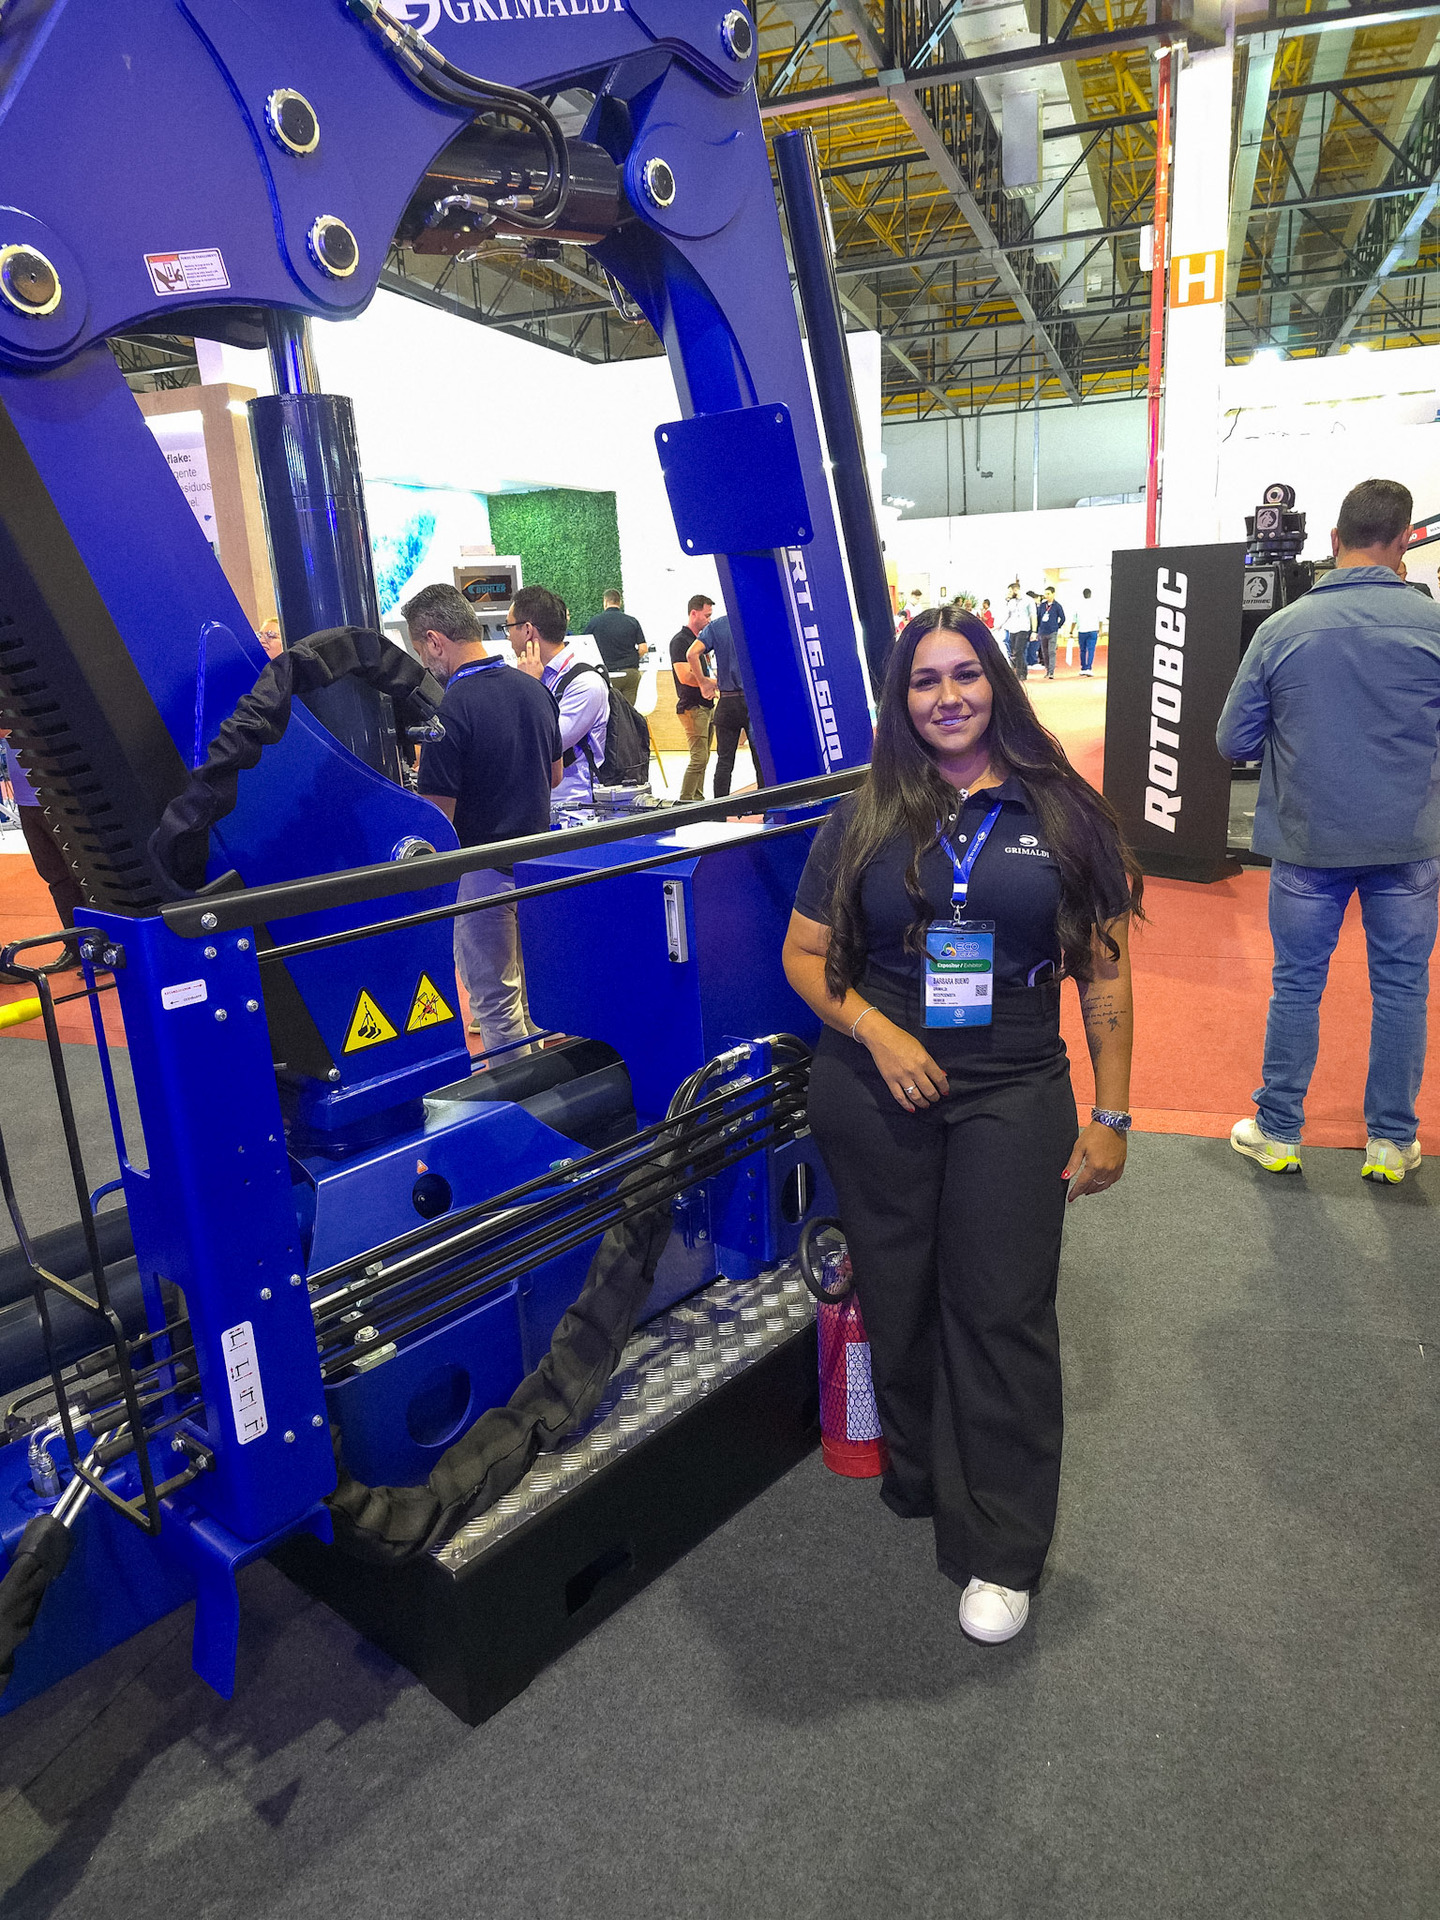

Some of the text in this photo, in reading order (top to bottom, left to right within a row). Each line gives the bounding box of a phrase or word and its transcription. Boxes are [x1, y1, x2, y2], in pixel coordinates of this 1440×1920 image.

[1178, 253, 1216, 303] H
[787, 545, 814, 612] RT
[1004, 846, 1050, 858] GRIMALDI
